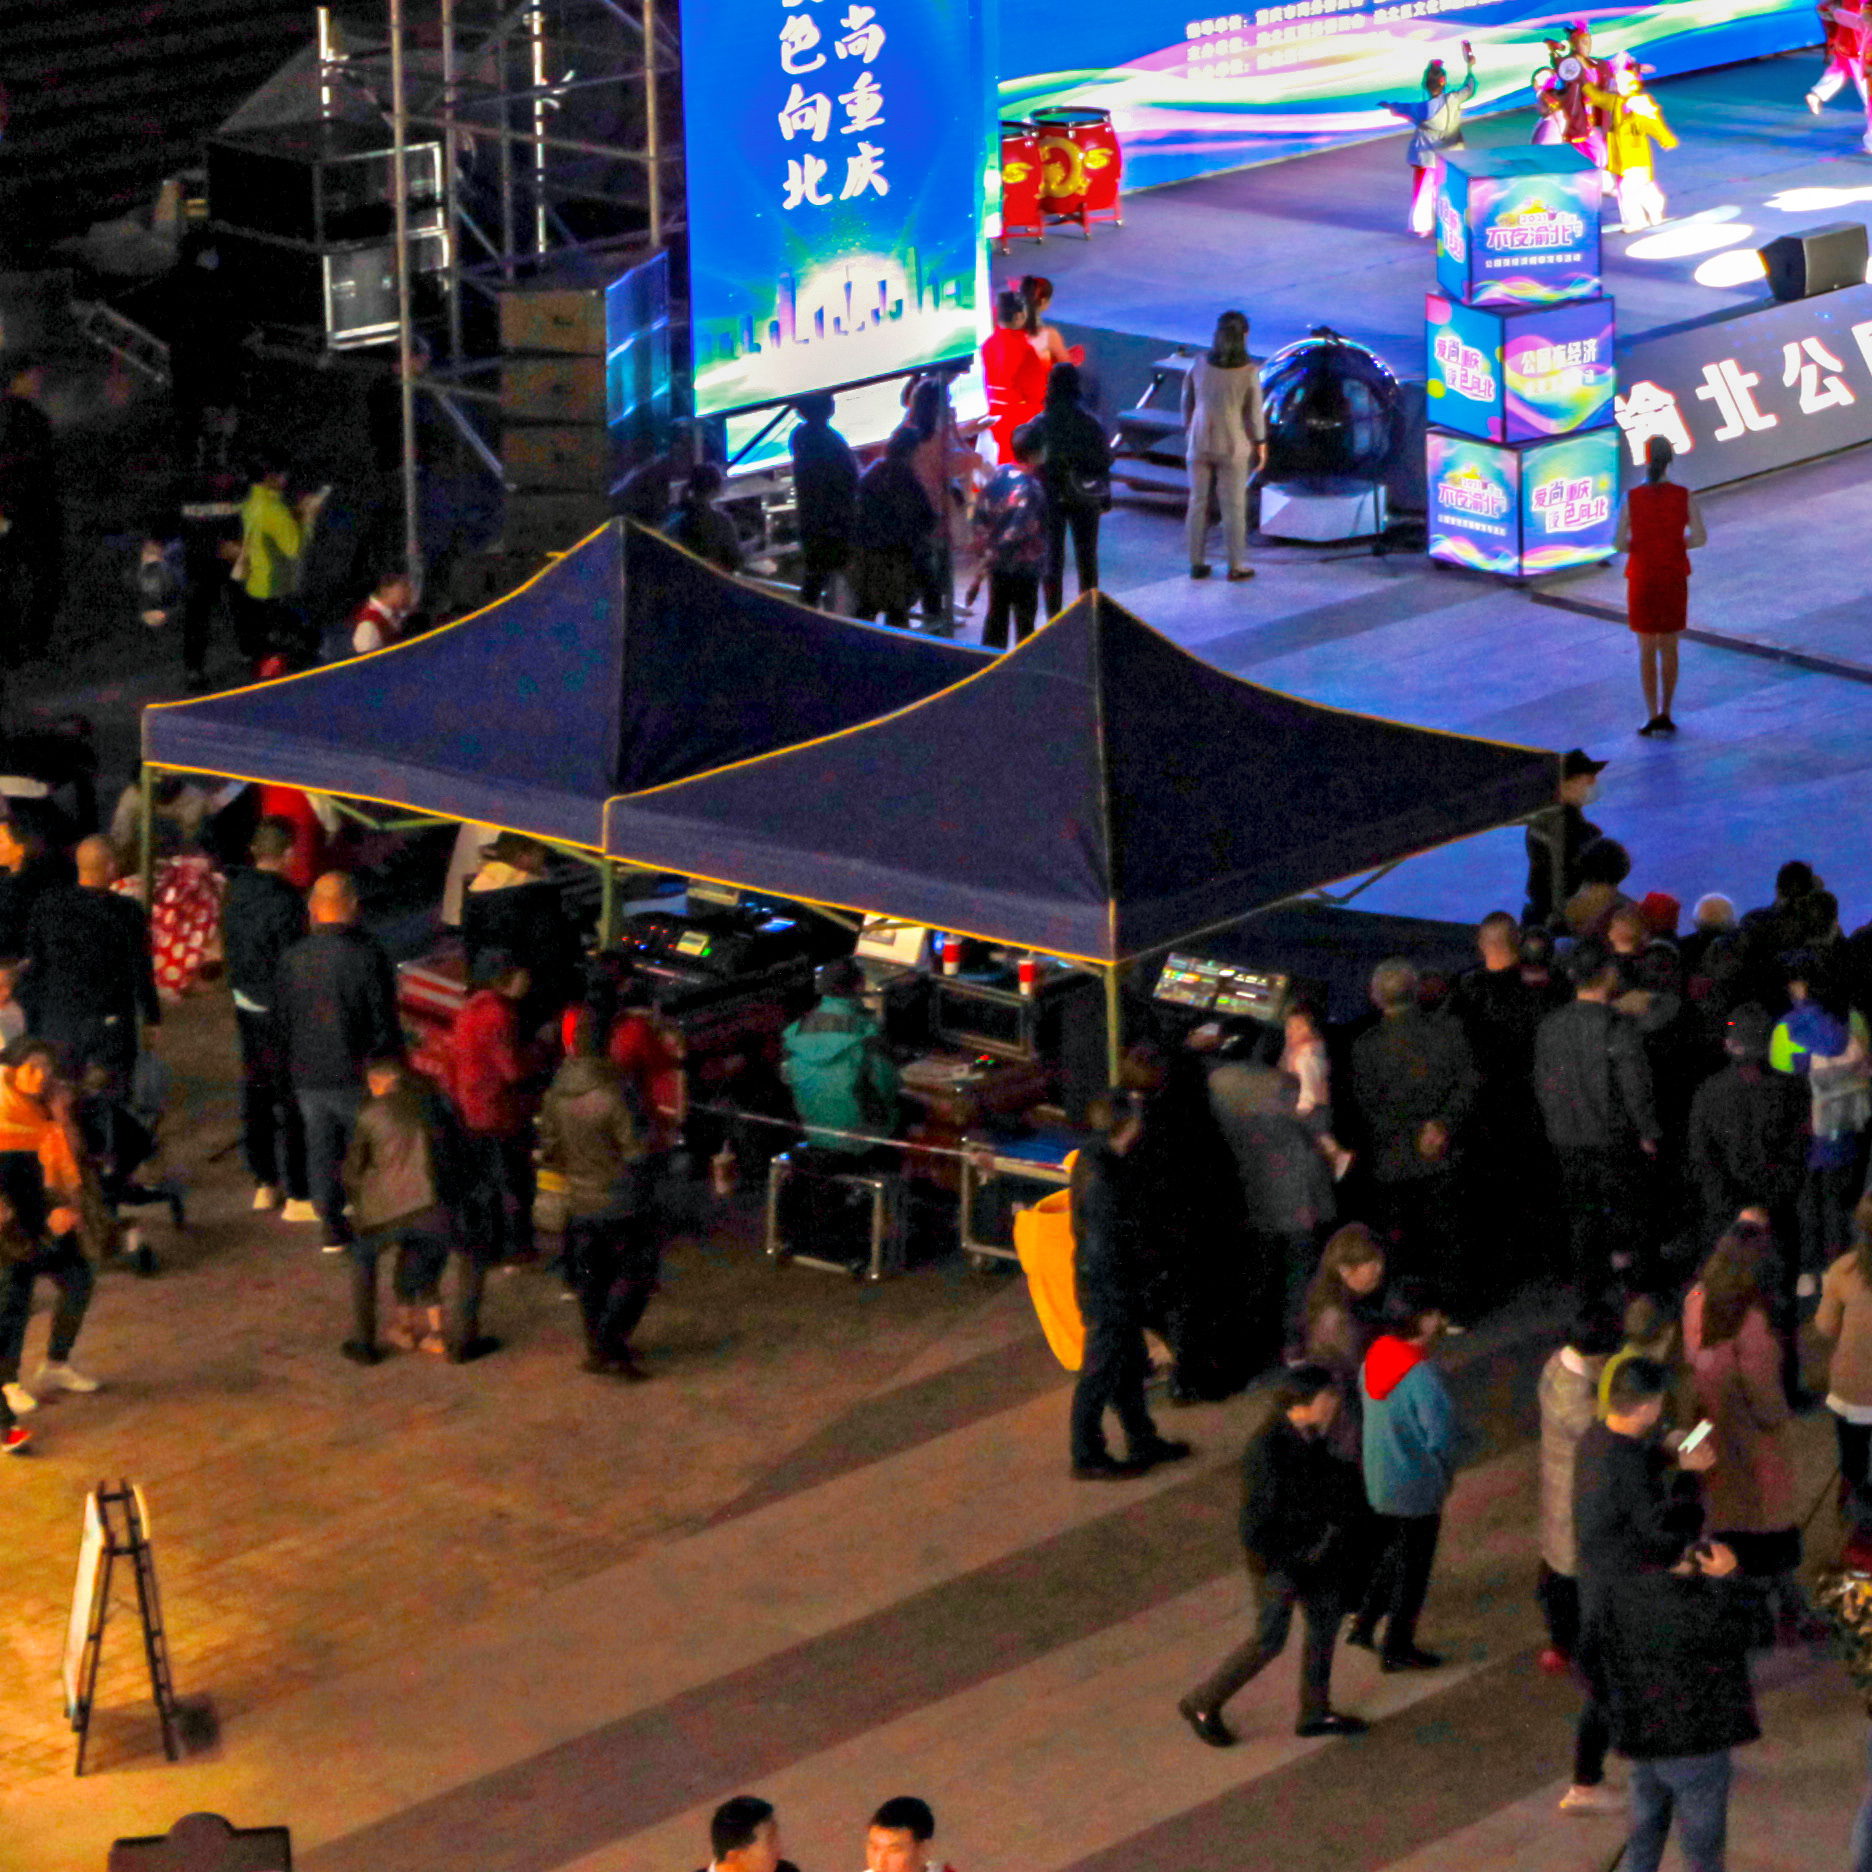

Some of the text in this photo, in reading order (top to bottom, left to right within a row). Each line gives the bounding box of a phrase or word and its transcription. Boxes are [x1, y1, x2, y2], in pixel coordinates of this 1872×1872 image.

[1486, 226, 1573, 251] 不夜渝北
[1438, 481, 1502, 518] 不夜渝北
[1533, 477, 1591, 511] 爱尚重庆
[1547, 494, 1608, 531] 夜色向北
